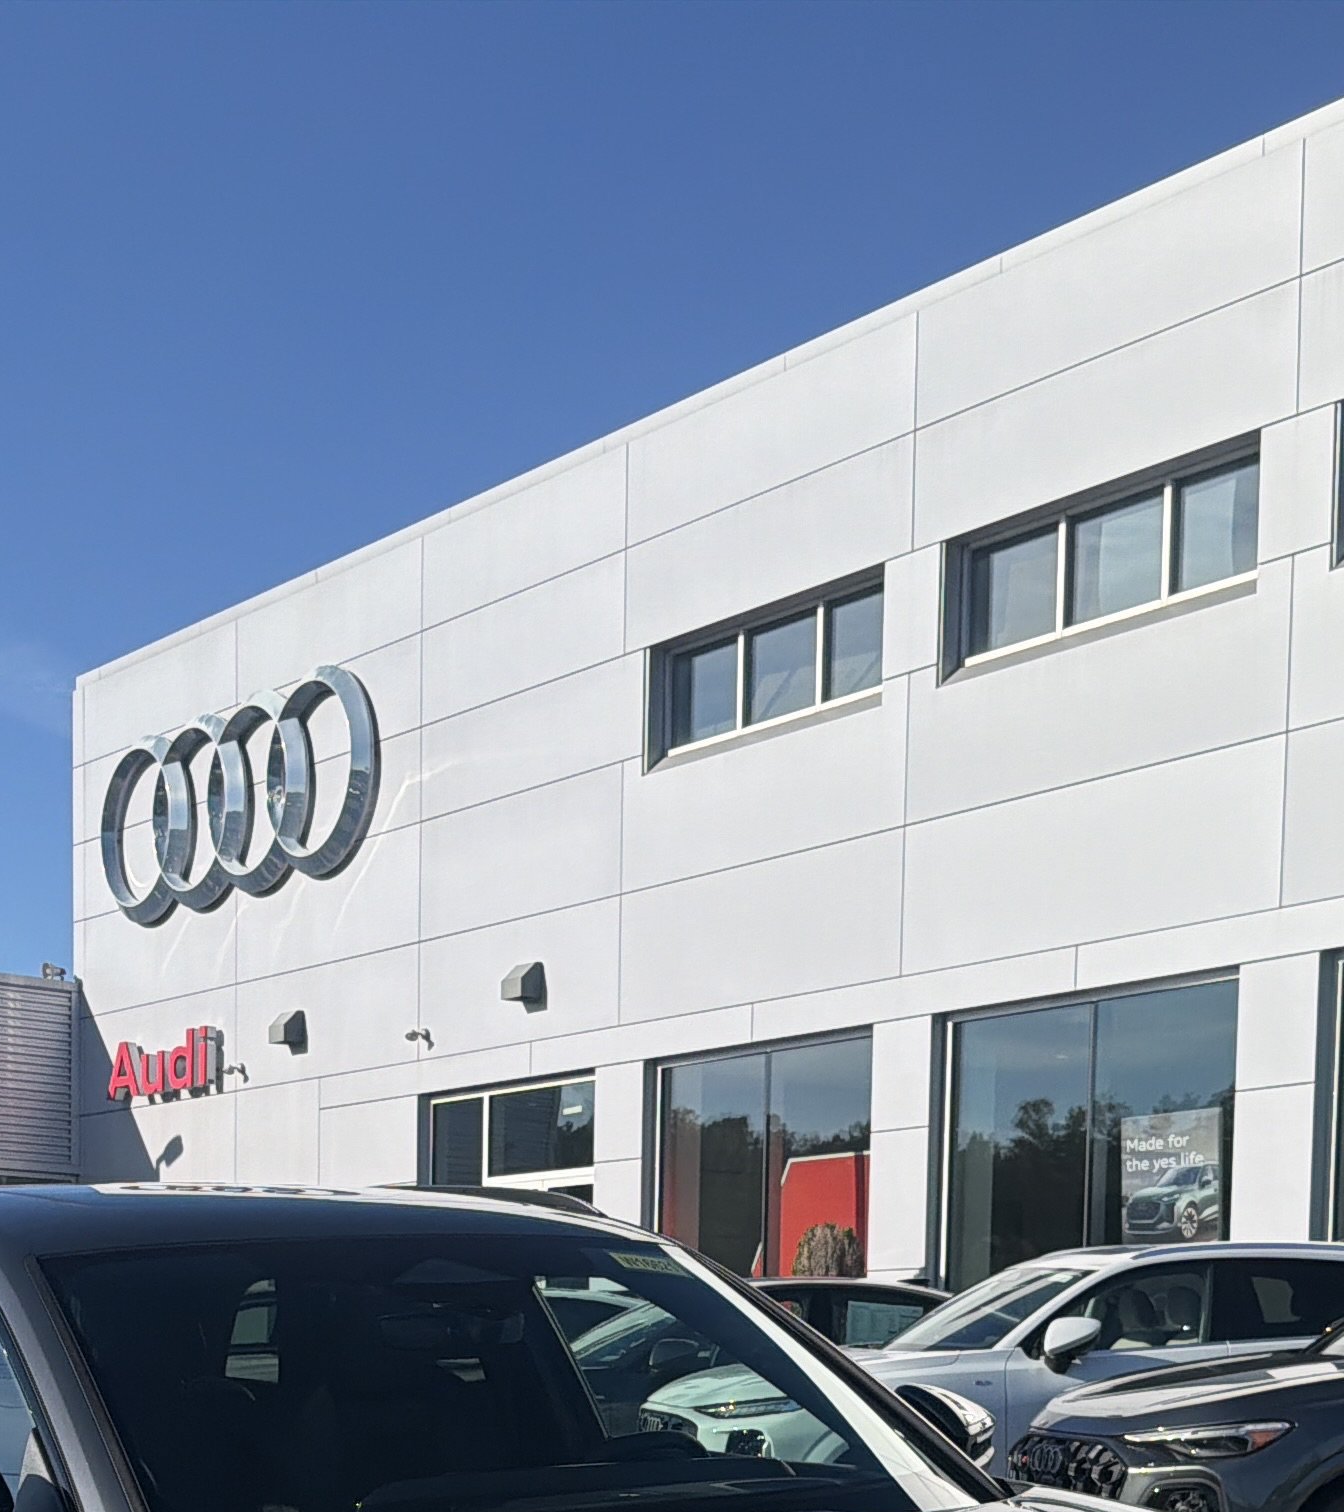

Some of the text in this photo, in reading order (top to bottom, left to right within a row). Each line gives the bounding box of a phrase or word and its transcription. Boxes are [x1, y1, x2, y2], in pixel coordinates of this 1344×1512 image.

[108, 1026, 215, 1100] Audi
[1126, 1134, 1190, 1152] Made for
[1126, 1151, 1204, 1173] the yes life
